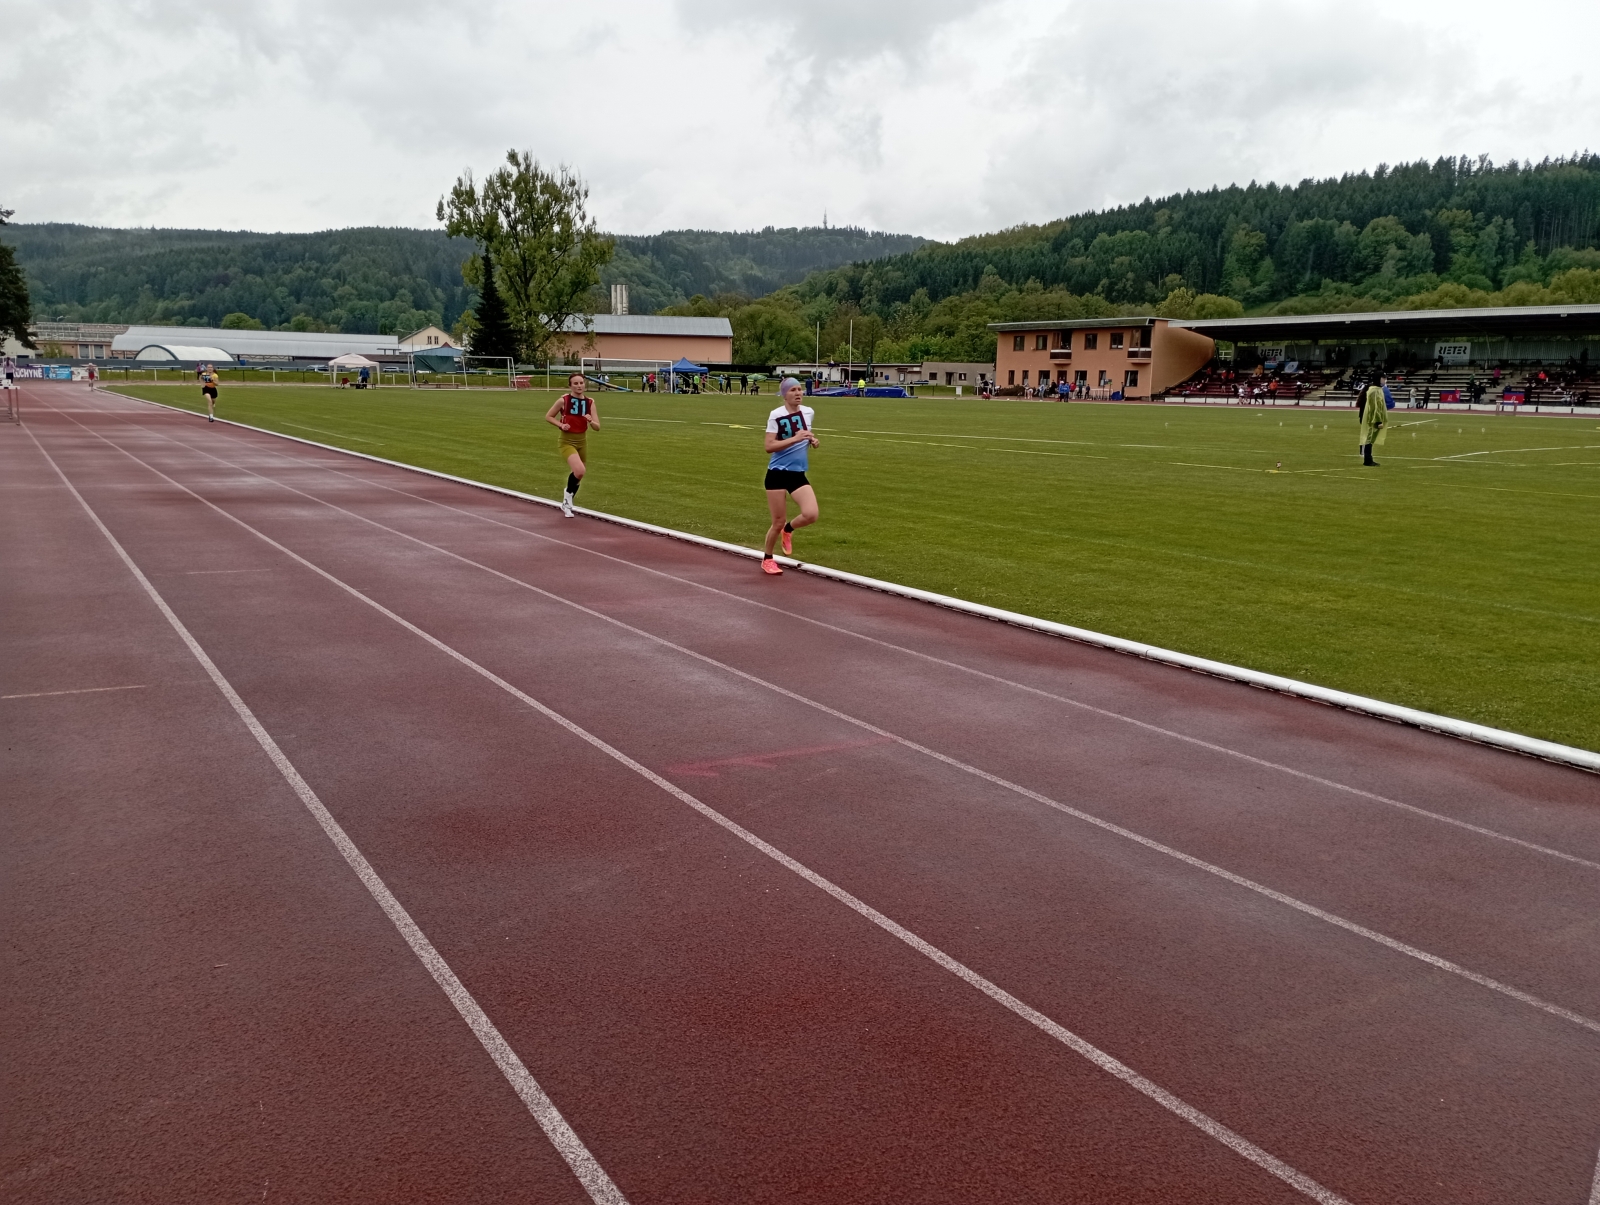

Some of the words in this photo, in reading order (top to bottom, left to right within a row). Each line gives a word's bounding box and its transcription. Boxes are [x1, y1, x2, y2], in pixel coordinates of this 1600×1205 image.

[1438, 346, 1467, 354] RIETER
[570, 398, 586, 416] 31
[780, 415, 803, 439] 33
